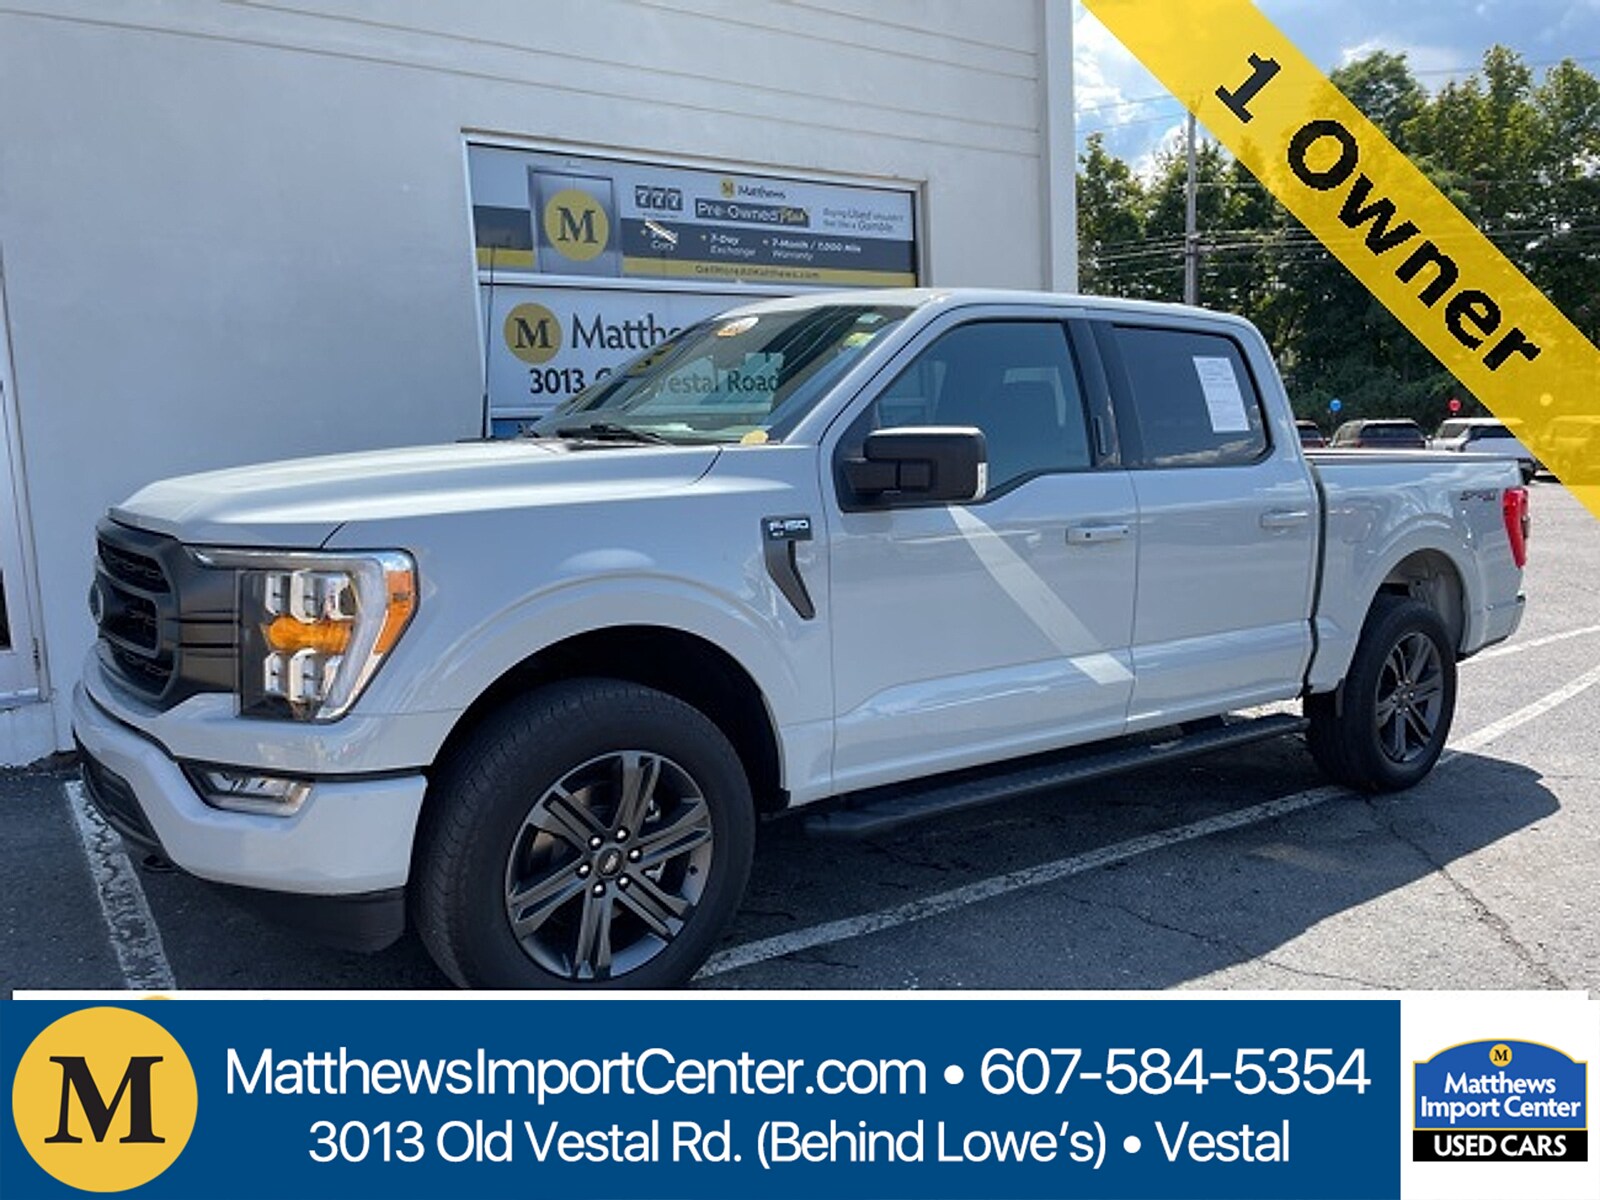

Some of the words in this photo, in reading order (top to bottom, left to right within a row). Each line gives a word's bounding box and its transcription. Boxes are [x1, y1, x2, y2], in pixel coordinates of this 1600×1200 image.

[738, 185, 786, 199] Matthews
[556, 207, 599, 243] M
[698, 202, 779, 222] Pre-Owned
[514, 317, 553, 348] M
[572, 313, 681, 349] Matth
[530, 367, 586, 394] 3013
[660, 370, 719, 393] estal
